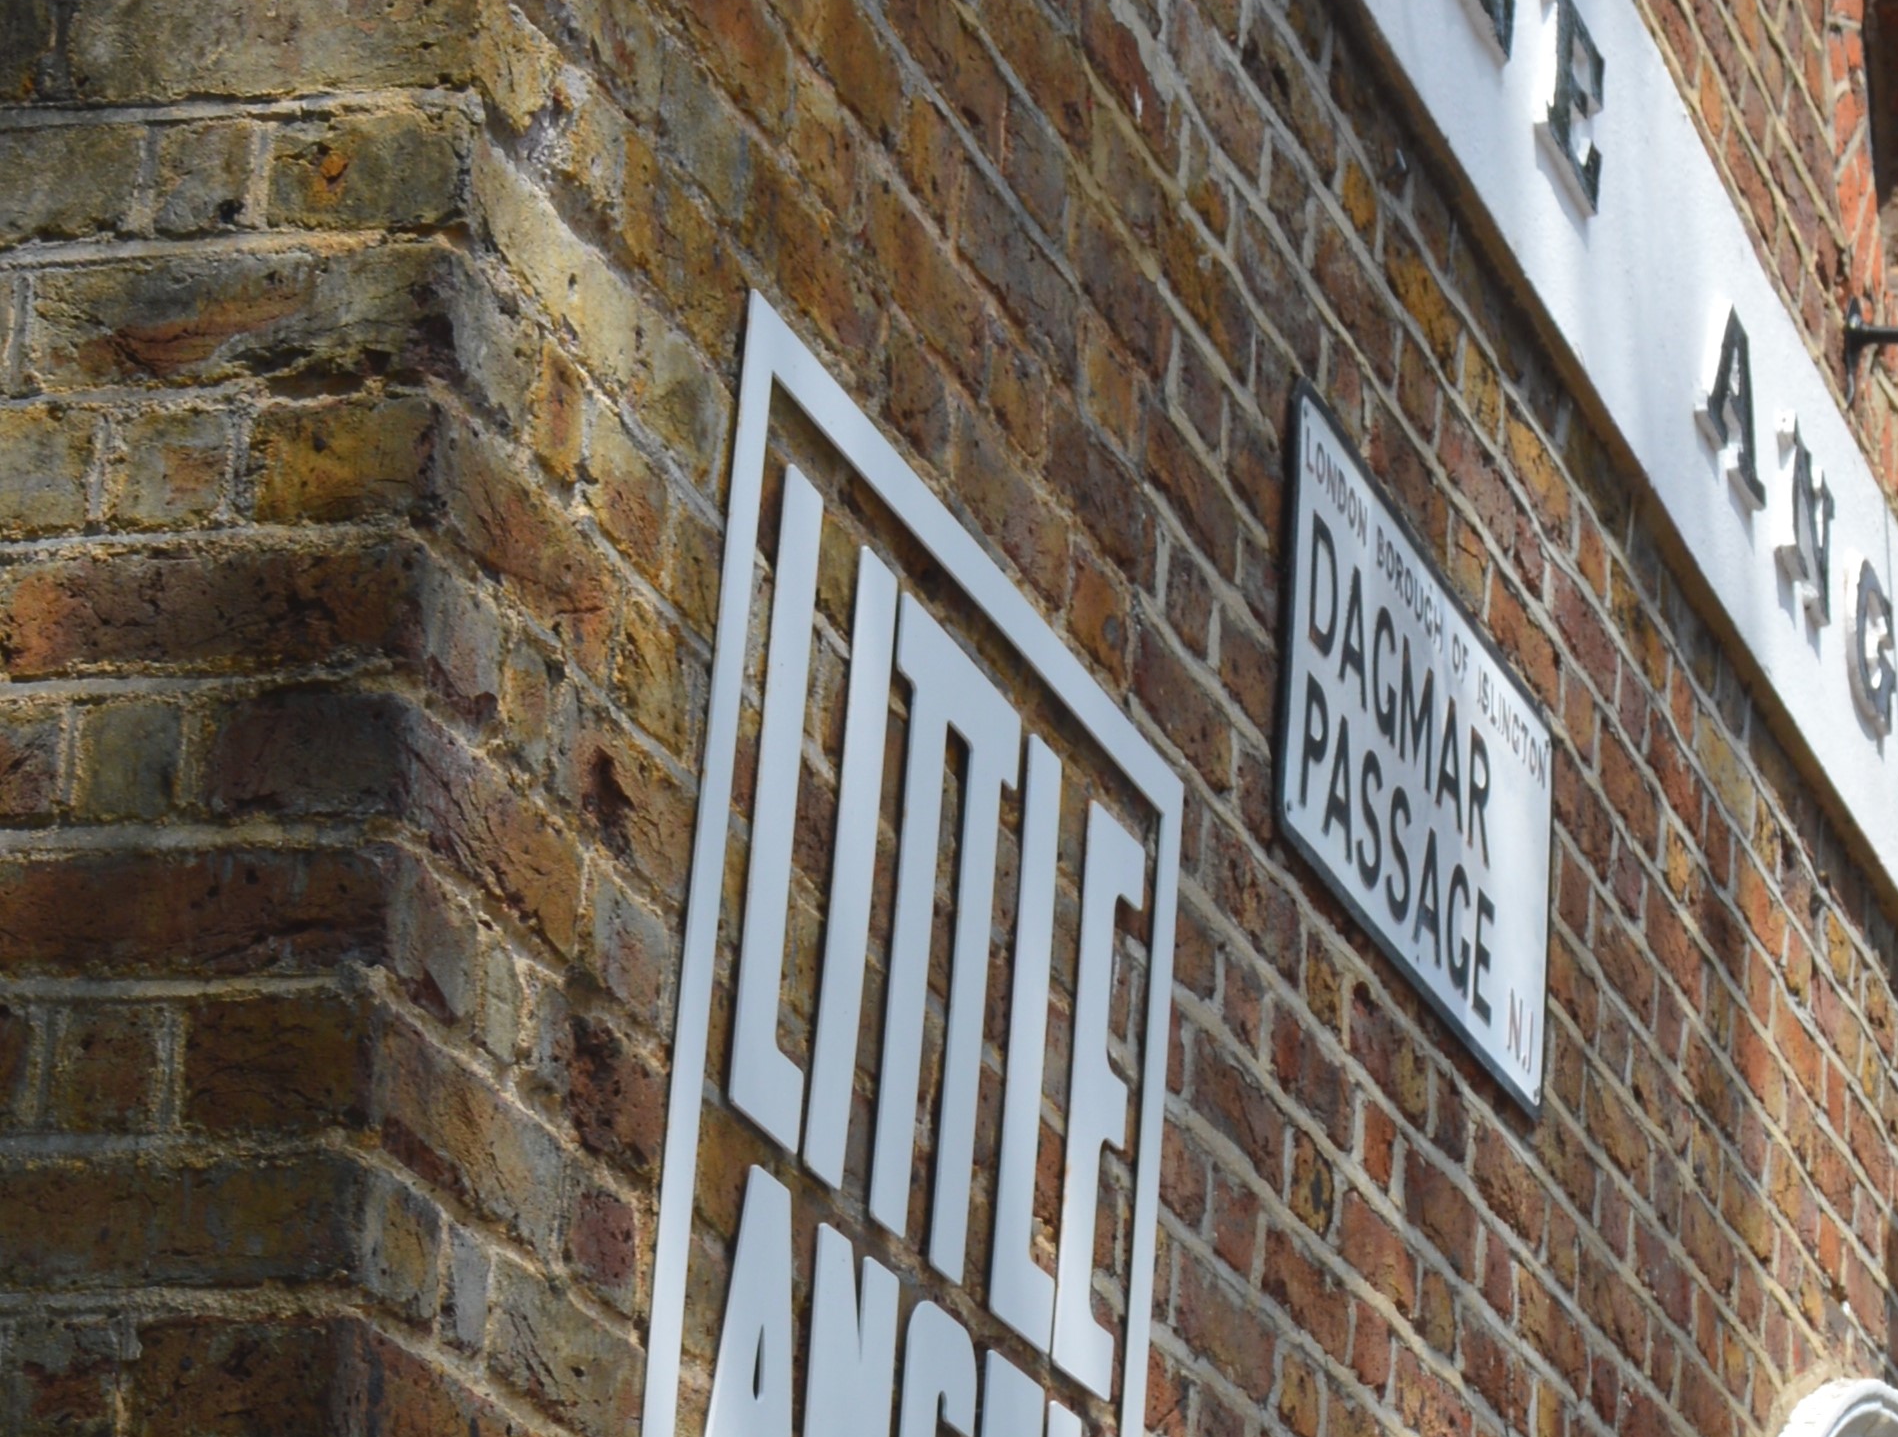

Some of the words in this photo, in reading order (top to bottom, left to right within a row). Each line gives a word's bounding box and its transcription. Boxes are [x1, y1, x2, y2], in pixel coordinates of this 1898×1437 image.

[1305, 425, 1368, 548] LONDON
[1376, 524, 1444, 654] BOROUGH
[1452, 632, 1470, 684] OF
[1476, 665, 1548, 790] ISLINGTON
[1308, 508, 1491, 867] DAGMAR
[729, 461, 1145, 1403] LITTLE
[1300, 671, 1495, 1027] PASSAGE
